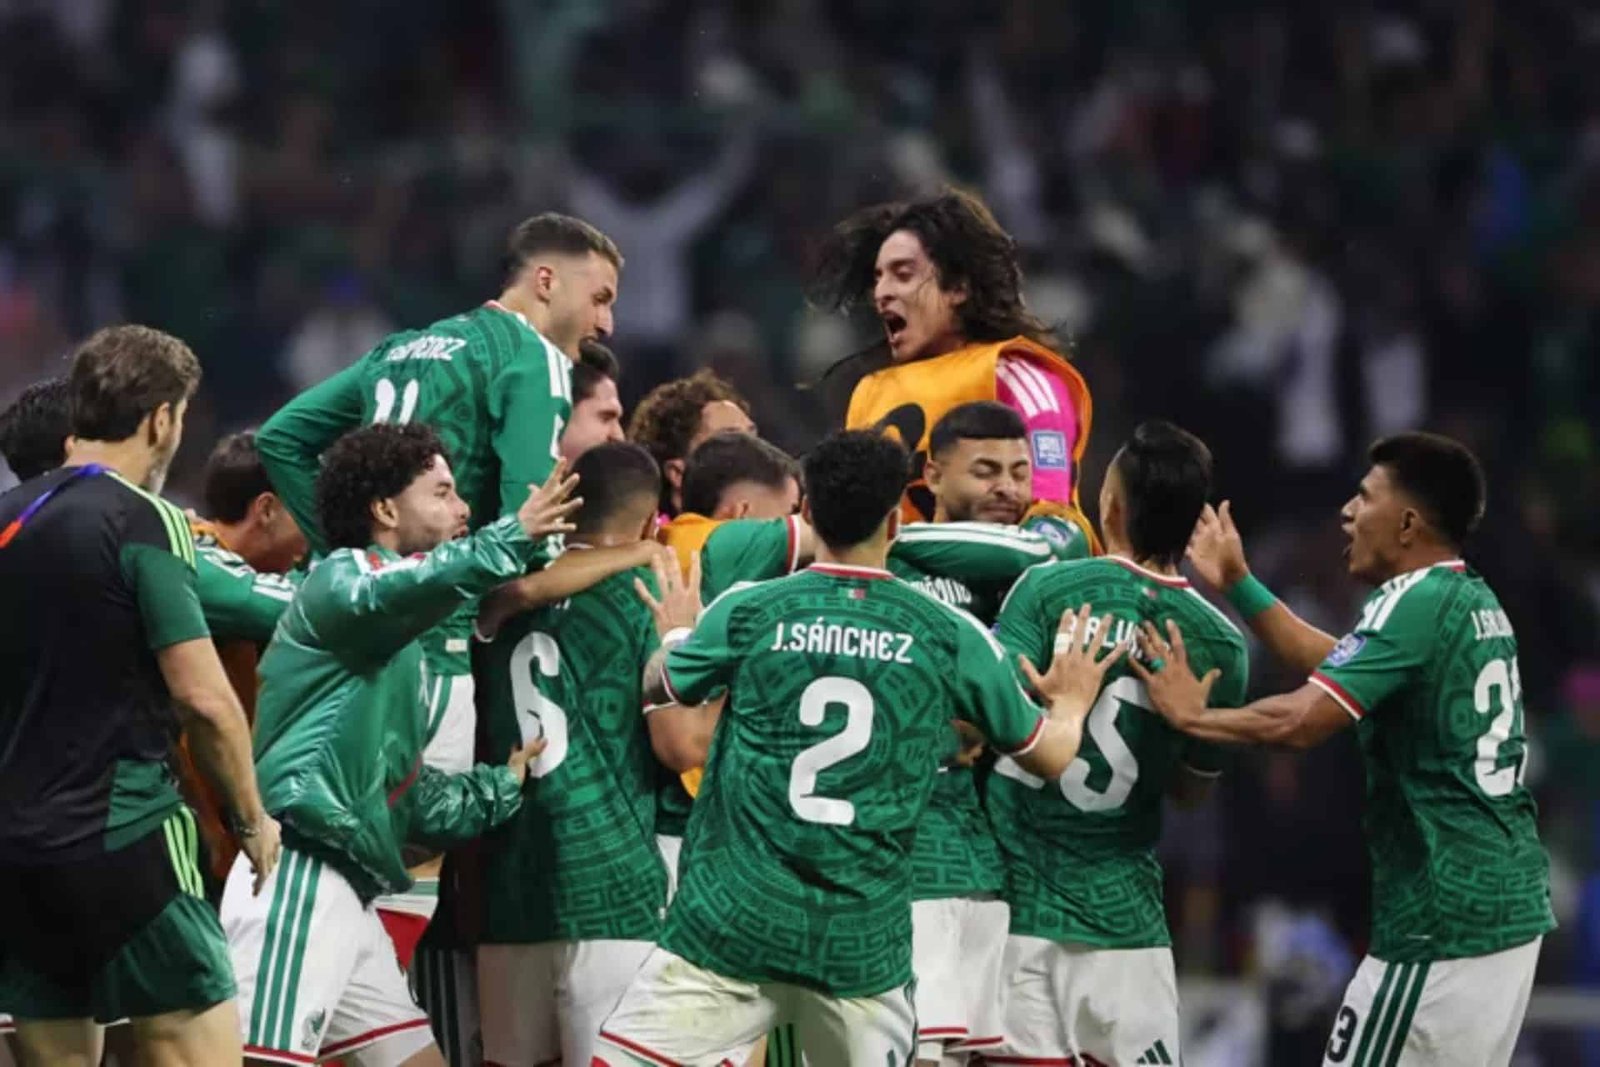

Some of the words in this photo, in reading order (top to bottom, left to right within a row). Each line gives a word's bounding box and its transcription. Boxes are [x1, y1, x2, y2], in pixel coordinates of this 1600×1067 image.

[510, 631, 568, 778] 6
[771, 617, 914, 663] J.SÁNCHEZ
[789, 676, 874, 826] 2
